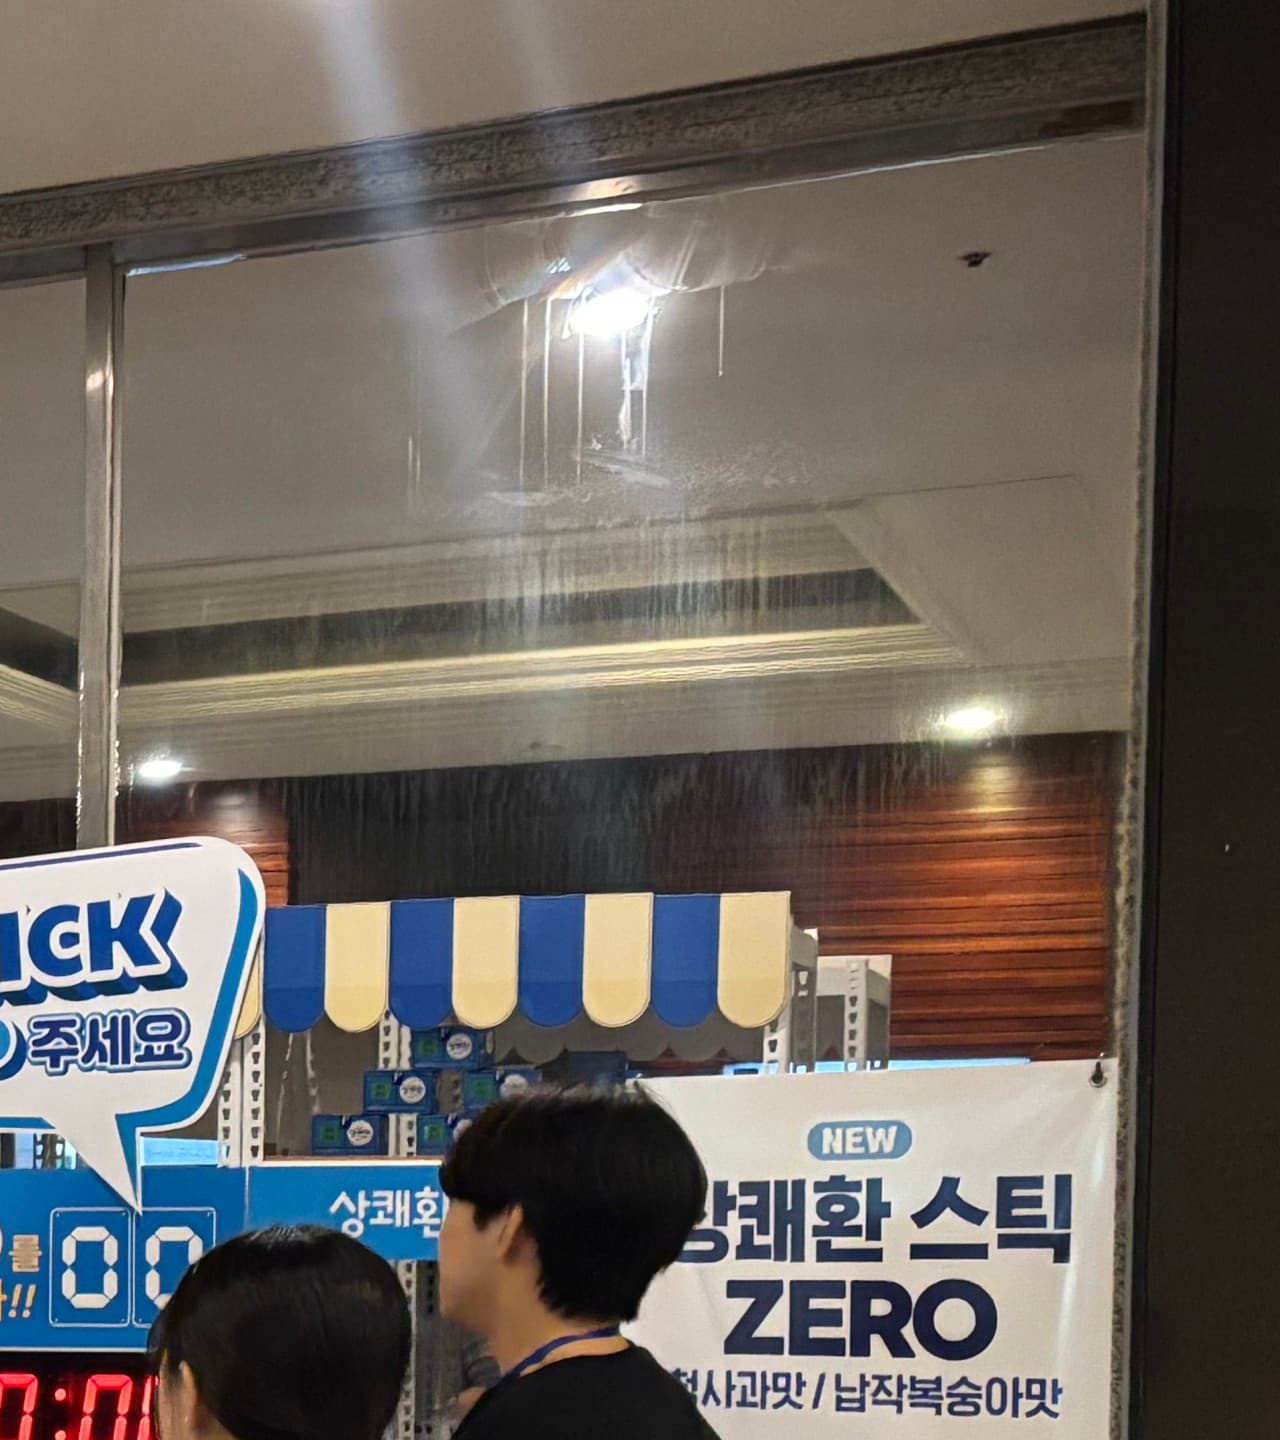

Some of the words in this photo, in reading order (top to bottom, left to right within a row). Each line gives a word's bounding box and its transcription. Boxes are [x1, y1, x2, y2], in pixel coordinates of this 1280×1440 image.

[30, 1011, 189, 1072] 주세요
[821, 1125, 898, 1155] NEW
[909, 1173, 1073, 1264] 스틱
[723, 1278, 998, 1361] ZERO
[834, 1372, 1064, 1419] 납작복숭아맛
